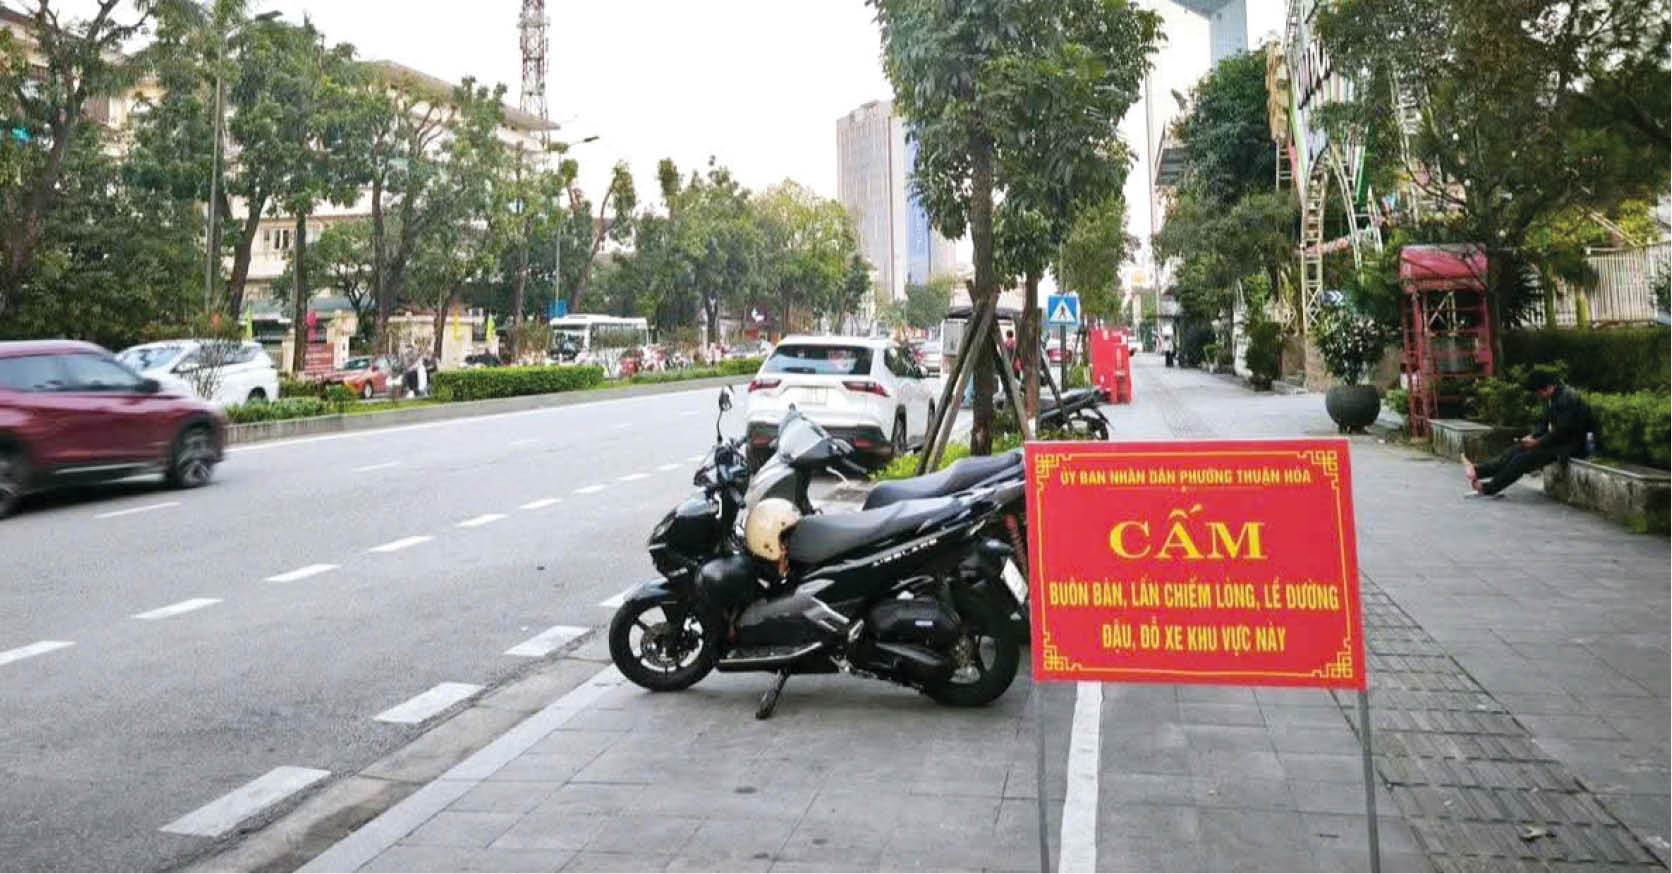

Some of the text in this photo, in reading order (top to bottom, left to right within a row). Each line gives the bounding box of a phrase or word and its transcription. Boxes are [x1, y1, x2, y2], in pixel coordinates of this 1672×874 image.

[1080, 469, 1106, 485] BAN
[1109, 503, 1268, 559] CẤM
[1164, 625, 1183, 651] XE
[1186, 625, 1218, 652] KHU
